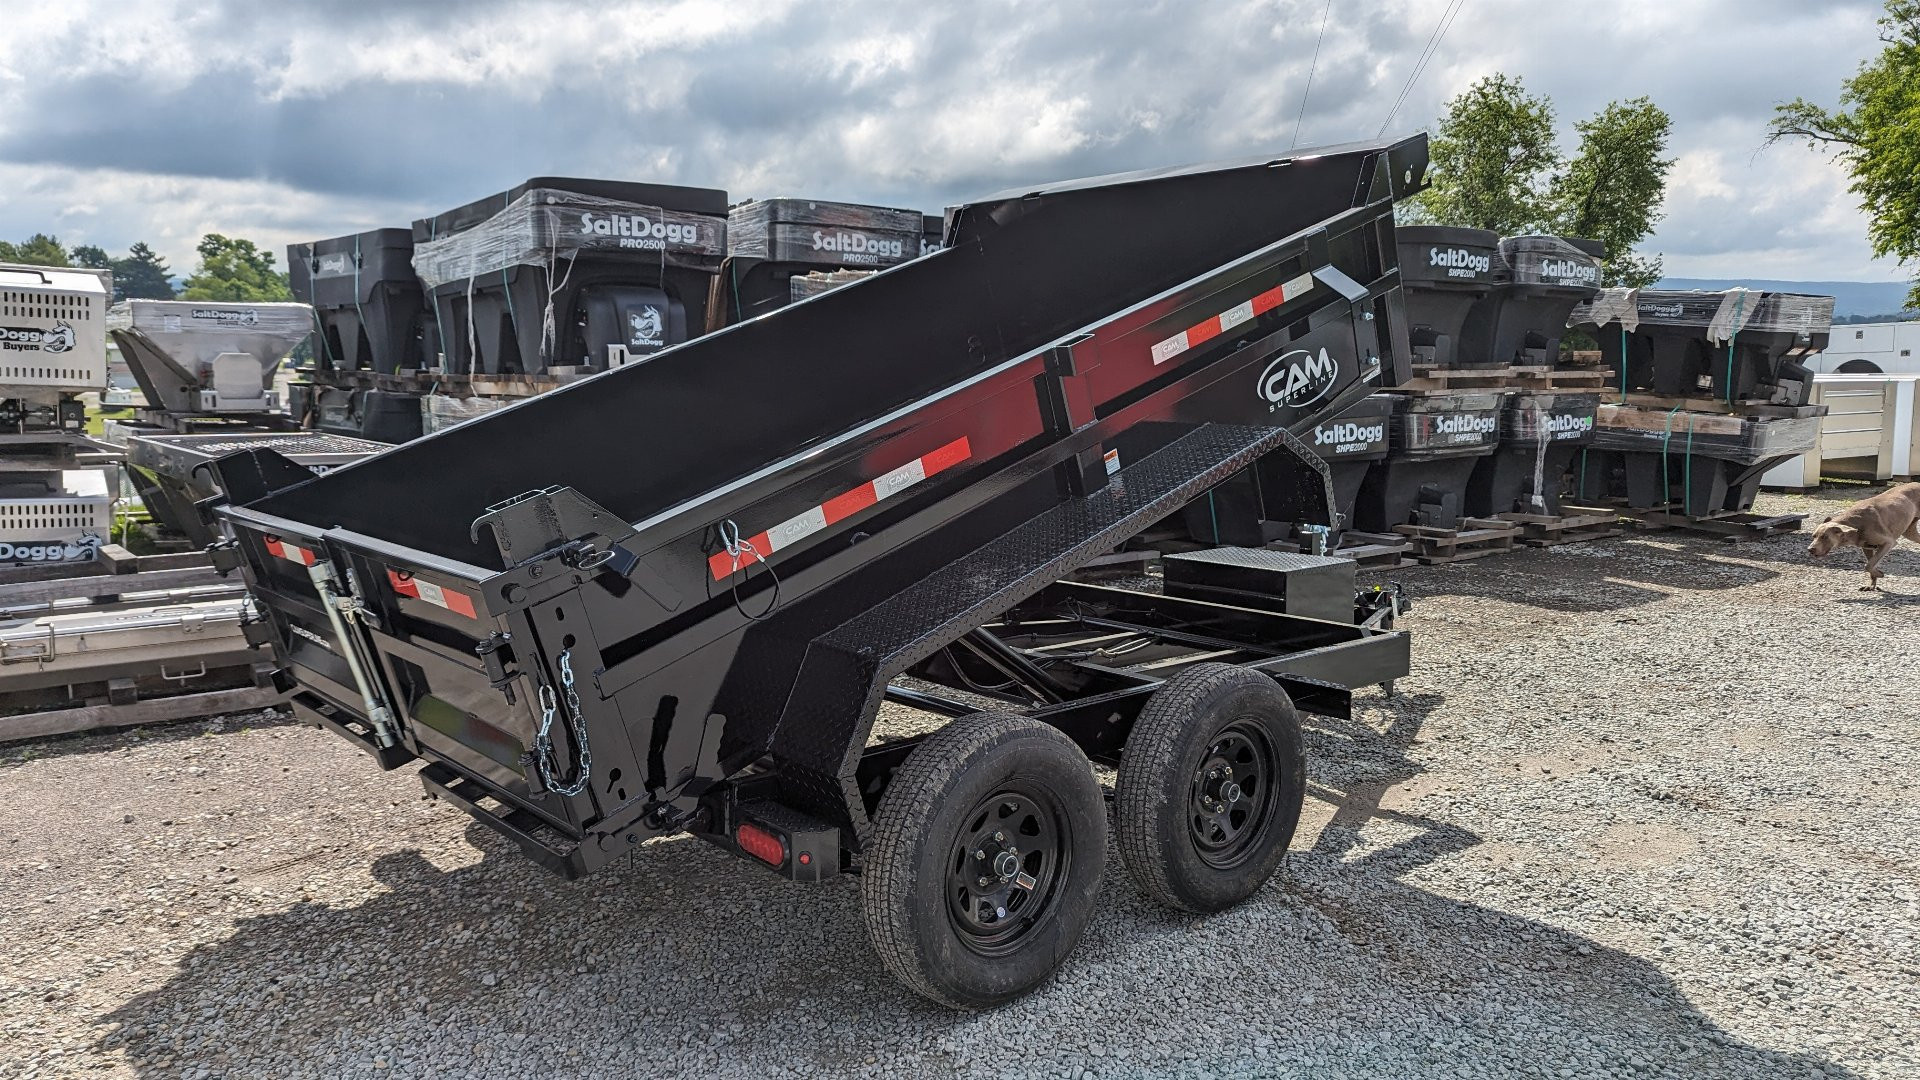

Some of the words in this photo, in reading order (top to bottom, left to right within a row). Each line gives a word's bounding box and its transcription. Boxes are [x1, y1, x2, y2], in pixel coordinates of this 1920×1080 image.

[581, 213, 697, 244] SaltDogg
[620, 239, 666, 250] PRO2500
[813, 231, 902, 258] SaltDogg
[843, 253, 878, 264] PRO2500
[1430, 247, 1490, 273] SaltDogg
[1448, 268, 1476, 279] SHPE2000
[1541, 259, 1596, 282] SaltDogg
[192, 310, 240, 320] SaltDogg
[3, 342, 40, 352] Buyers
[631, 338, 664, 346] SaltDogg
[1265, 347, 1332, 402] CAM
[1269, 370, 1334, 413] SUPERLINE
[1437, 414, 1495, 434] SaltDogg
[1314, 422, 1384, 446] SaltDogg
[1335, 441, 1368, 454] SHPE2000
[889, 472, 911, 486] CAM
[785, 519, 811, 536] CAM
[0, 542, 63, 561] Dogg
